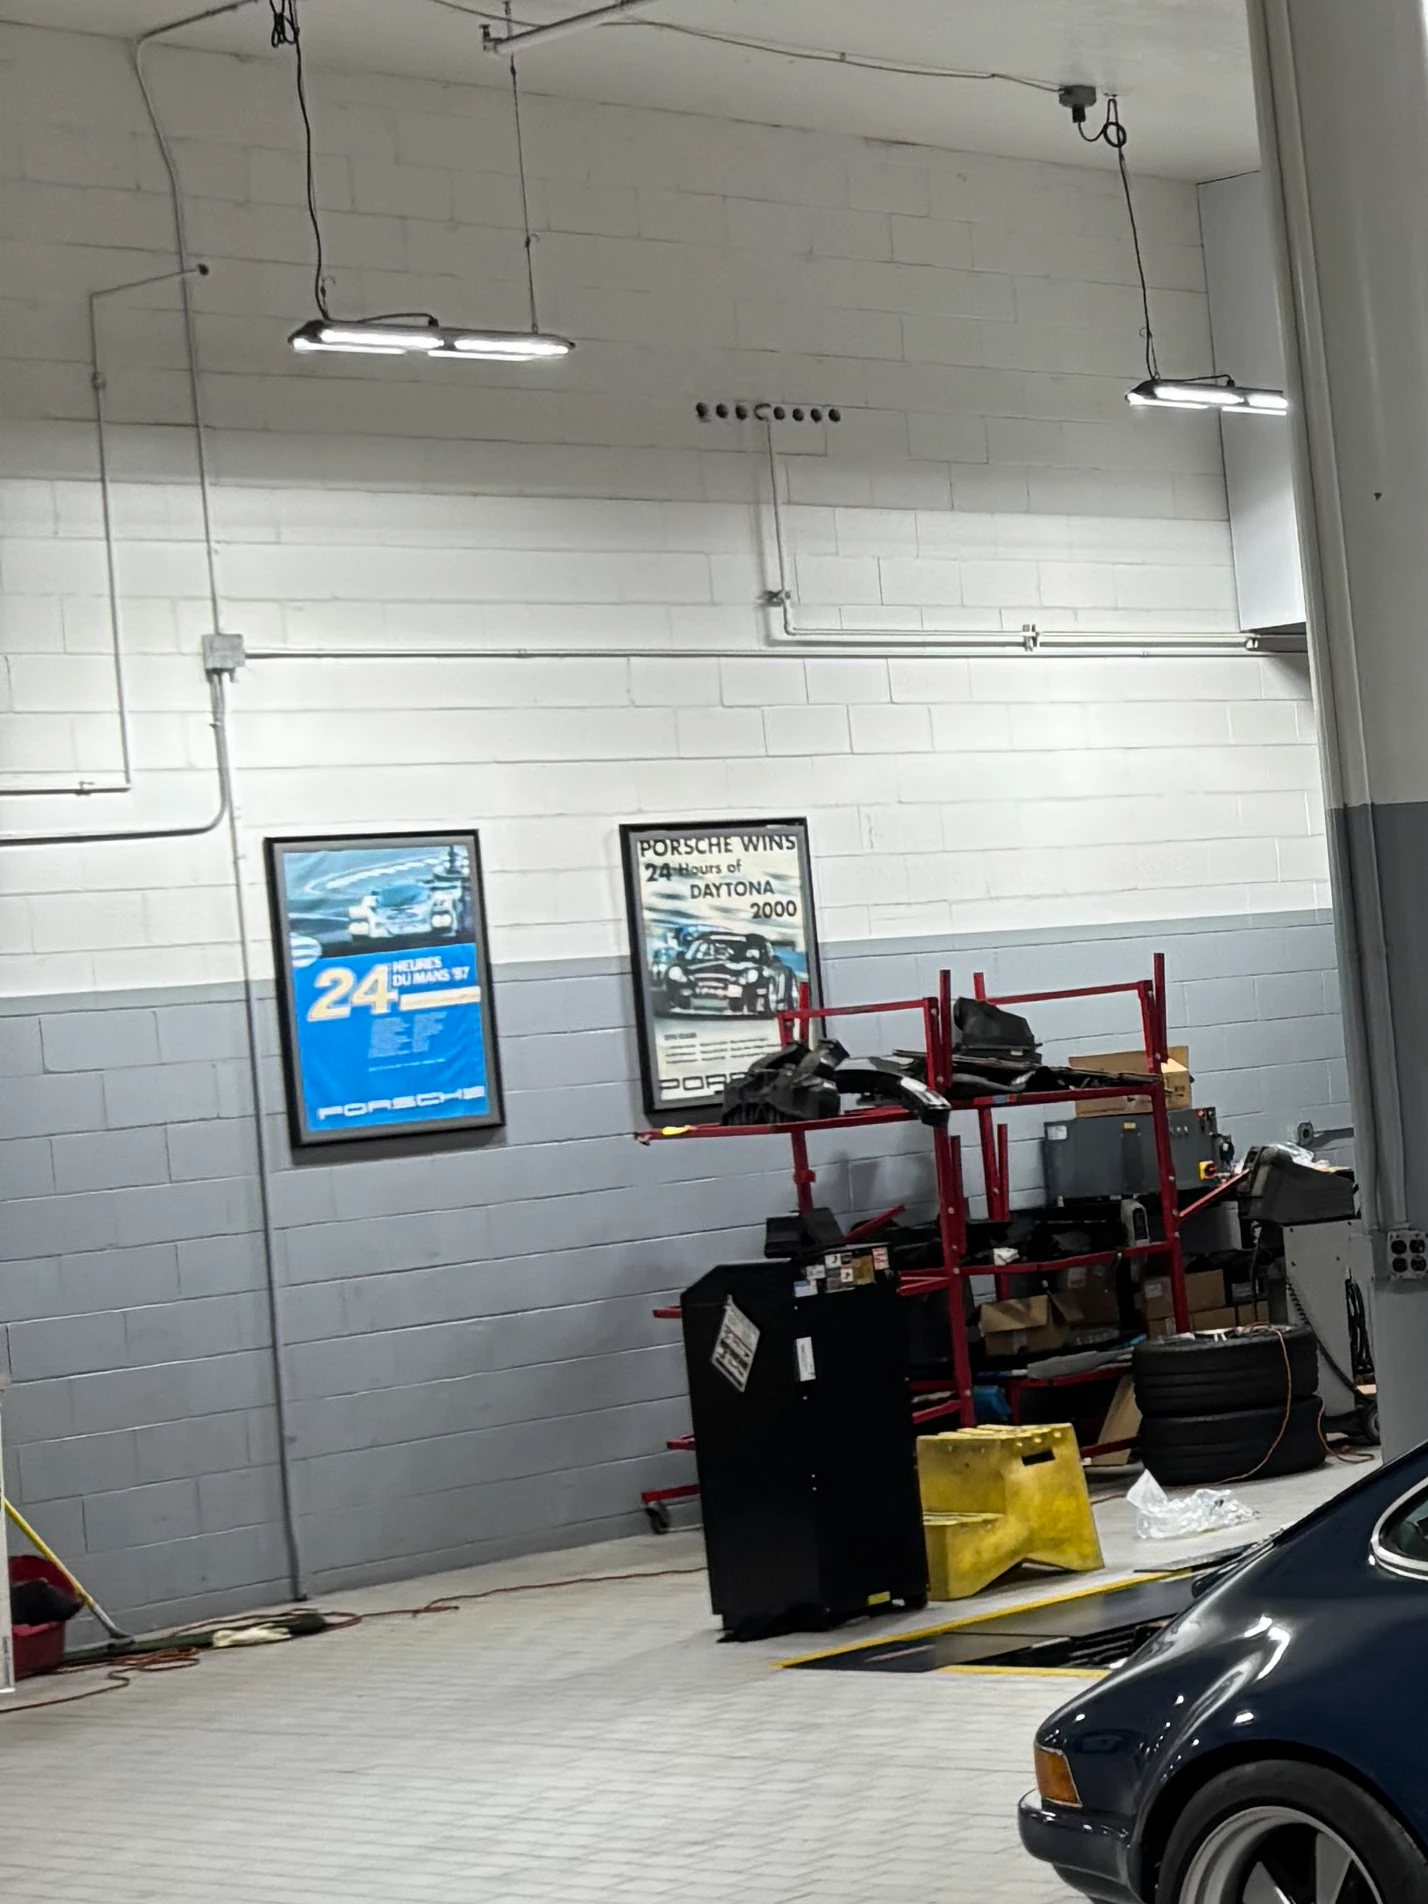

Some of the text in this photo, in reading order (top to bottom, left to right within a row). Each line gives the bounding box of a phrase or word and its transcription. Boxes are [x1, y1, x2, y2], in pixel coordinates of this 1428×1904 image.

[639, 835, 796, 857] PORSCHE WINS
[645, 858, 742, 882] 24 Hours of
[690, 880, 775, 899] DAYTONA
[750, 900, 797, 919] 2000
[392, 971, 411, 986] DU
[412, 968, 450, 984] MANS
[307, 962, 399, 1022] 24
